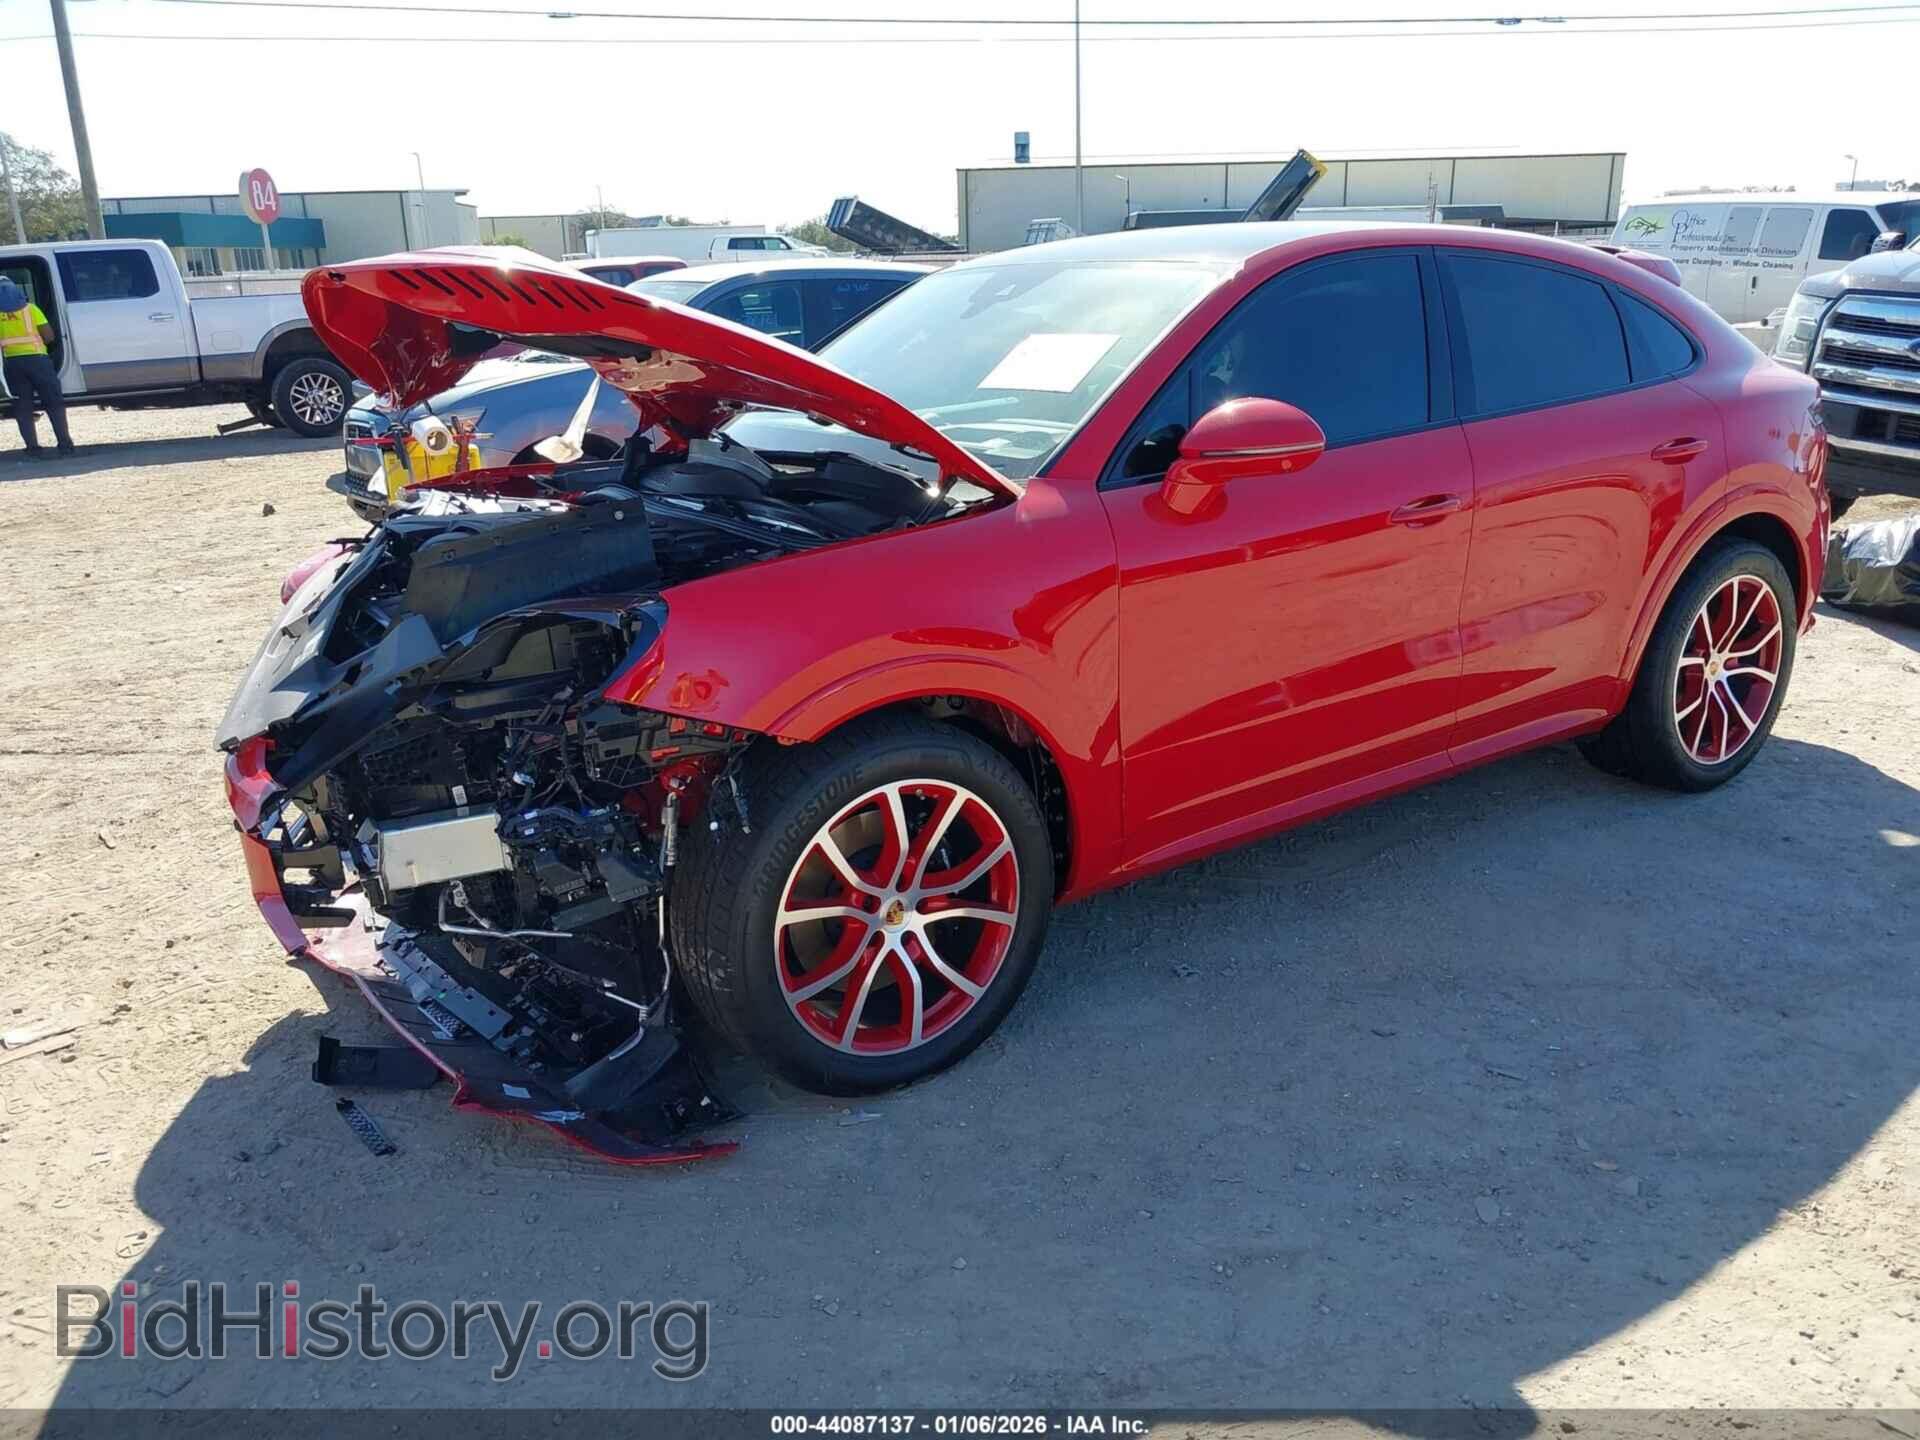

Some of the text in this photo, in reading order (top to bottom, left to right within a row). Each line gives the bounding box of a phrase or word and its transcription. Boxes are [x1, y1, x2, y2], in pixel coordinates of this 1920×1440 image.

[252, 180, 276, 211] 84
[1670, 244, 1704, 254] Property
[1707, 245, 1758, 255] Maintenance
[1761, 247, 1797, 257] Division
[1733, 259, 1759, 268] Window
[1762, 260, 1794, 271] Cleaning
[754, 765, 864, 896] BRIDGESTONE
